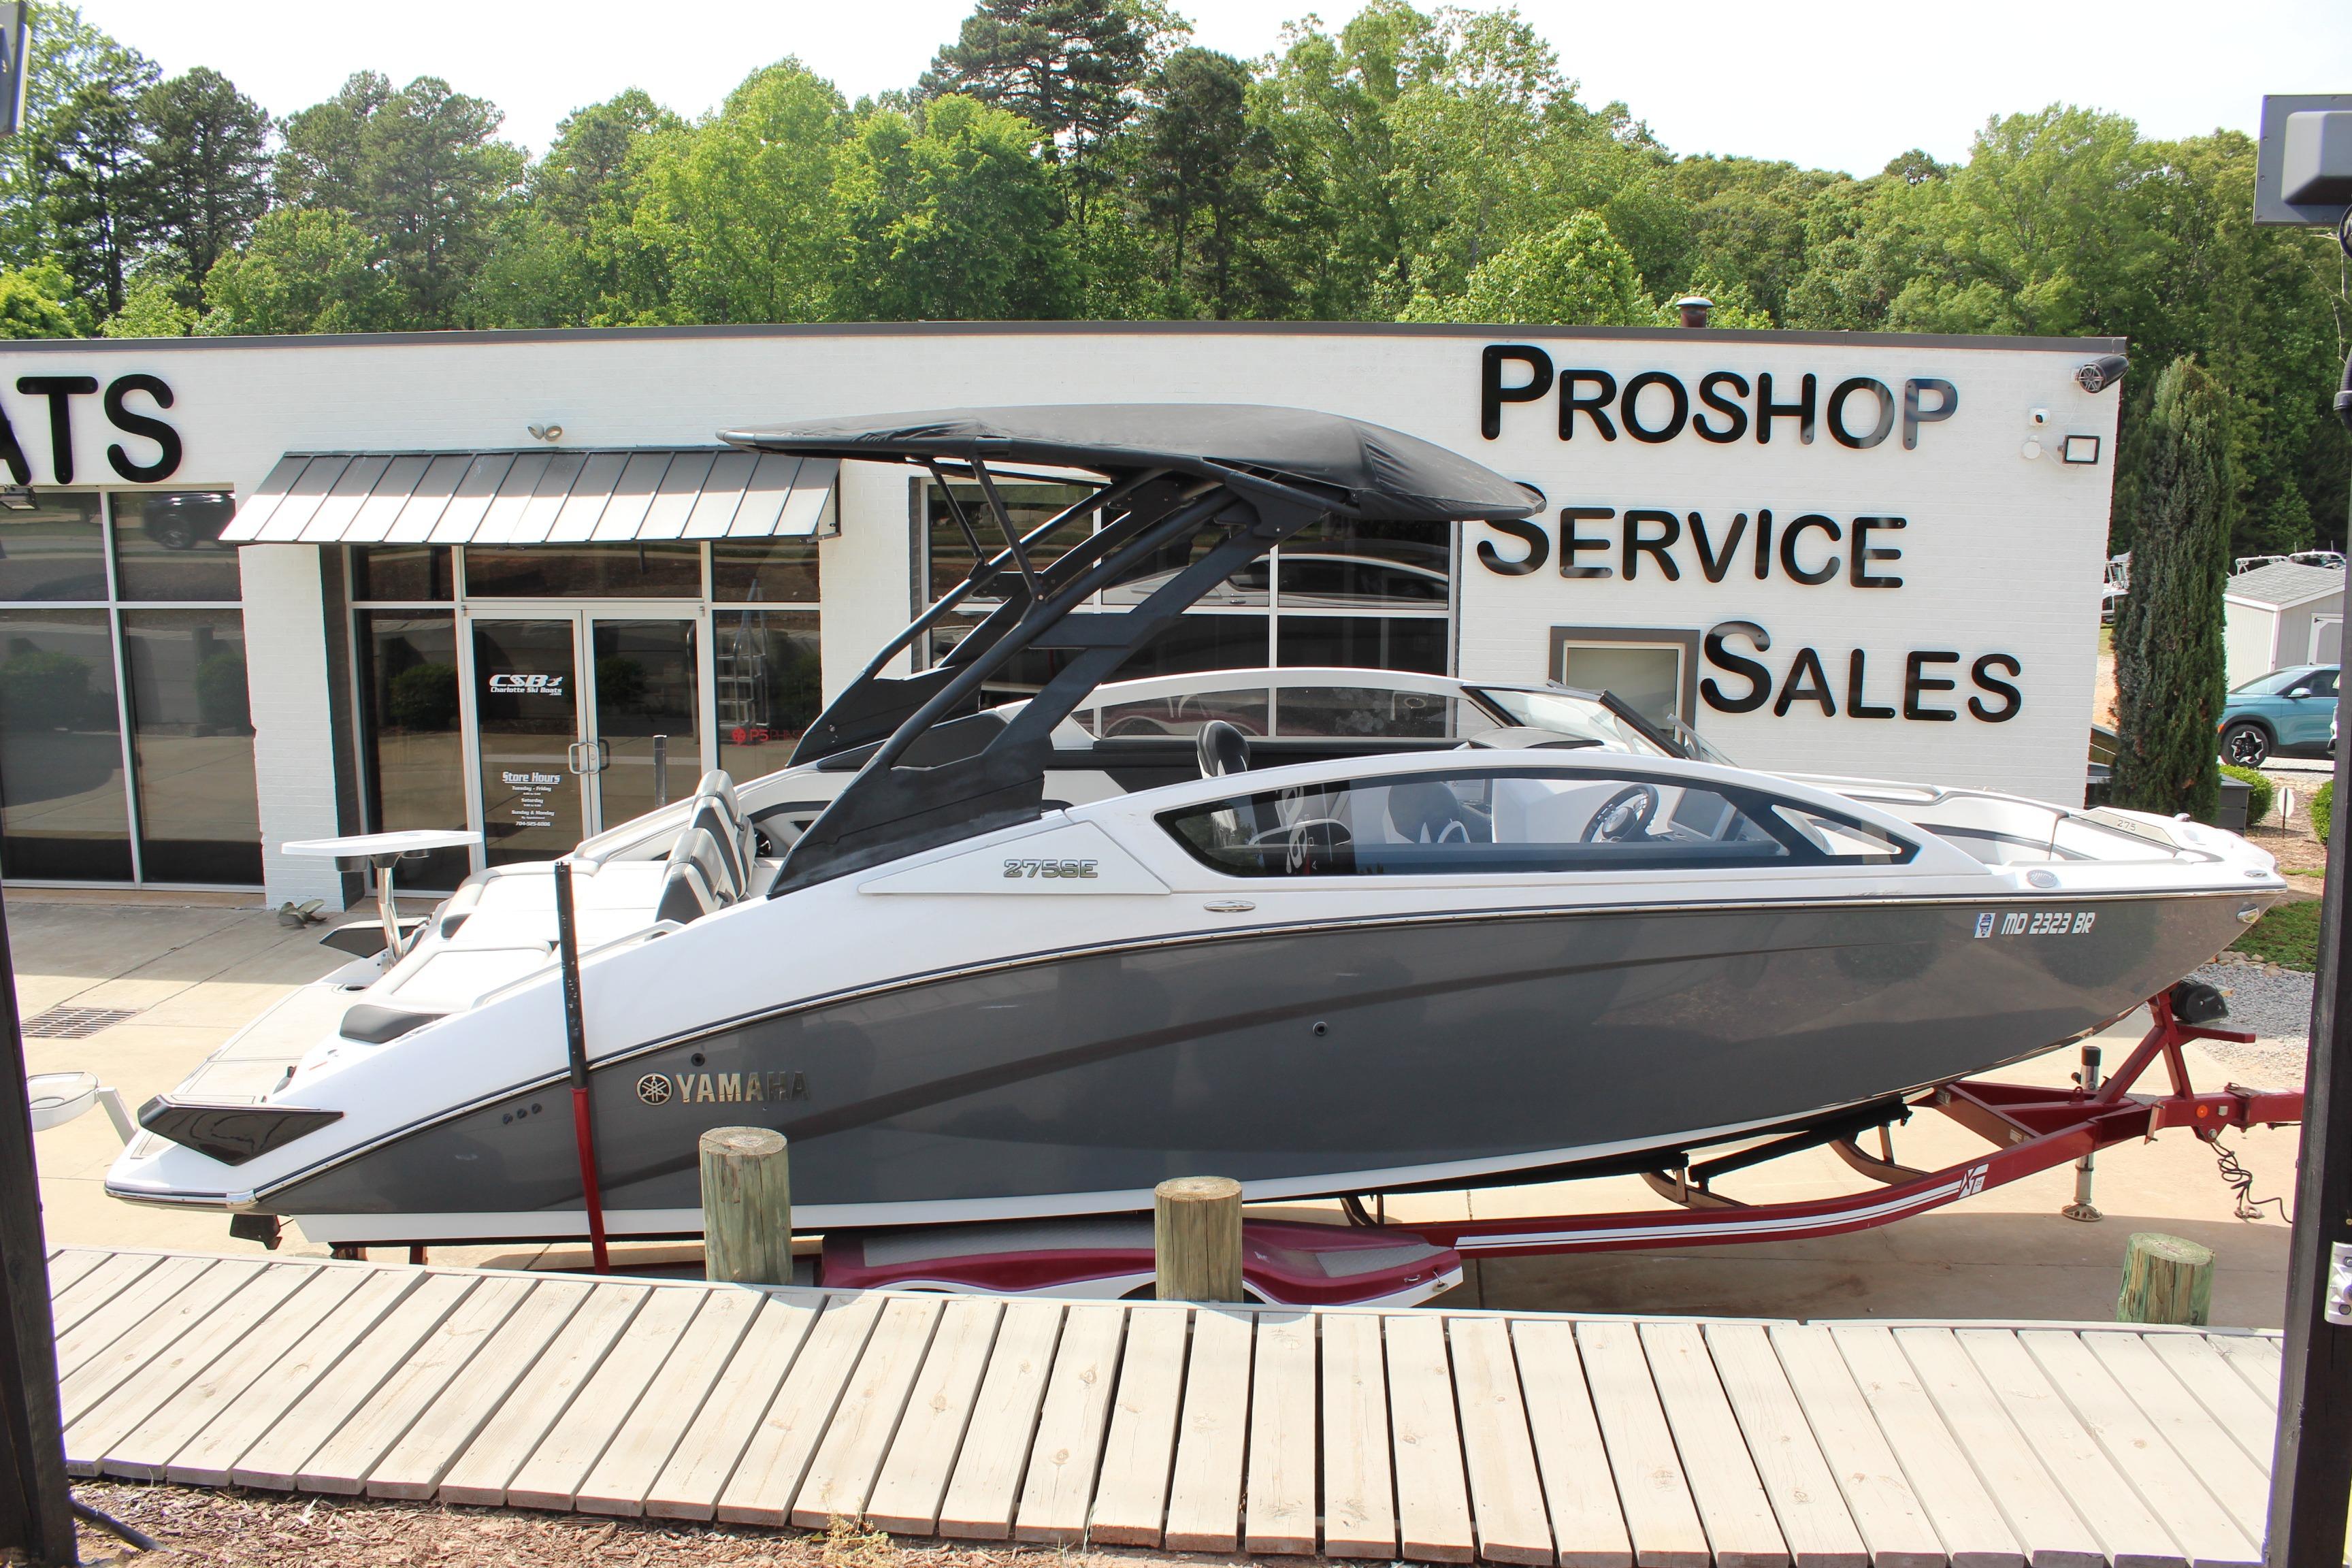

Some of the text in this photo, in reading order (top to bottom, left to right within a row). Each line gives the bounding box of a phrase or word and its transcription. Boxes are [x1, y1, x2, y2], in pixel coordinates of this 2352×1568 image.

[489, 674, 549, 687] CSB
[502, 771, 560, 783] Store Hours
[2117, 819, 2136, 831] 275
[1003, 859, 1098, 878] 275SE
[2000, 912, 2096, 935] MD 2323 BR
[675, 1071, 810, 1103] YAMAHA
